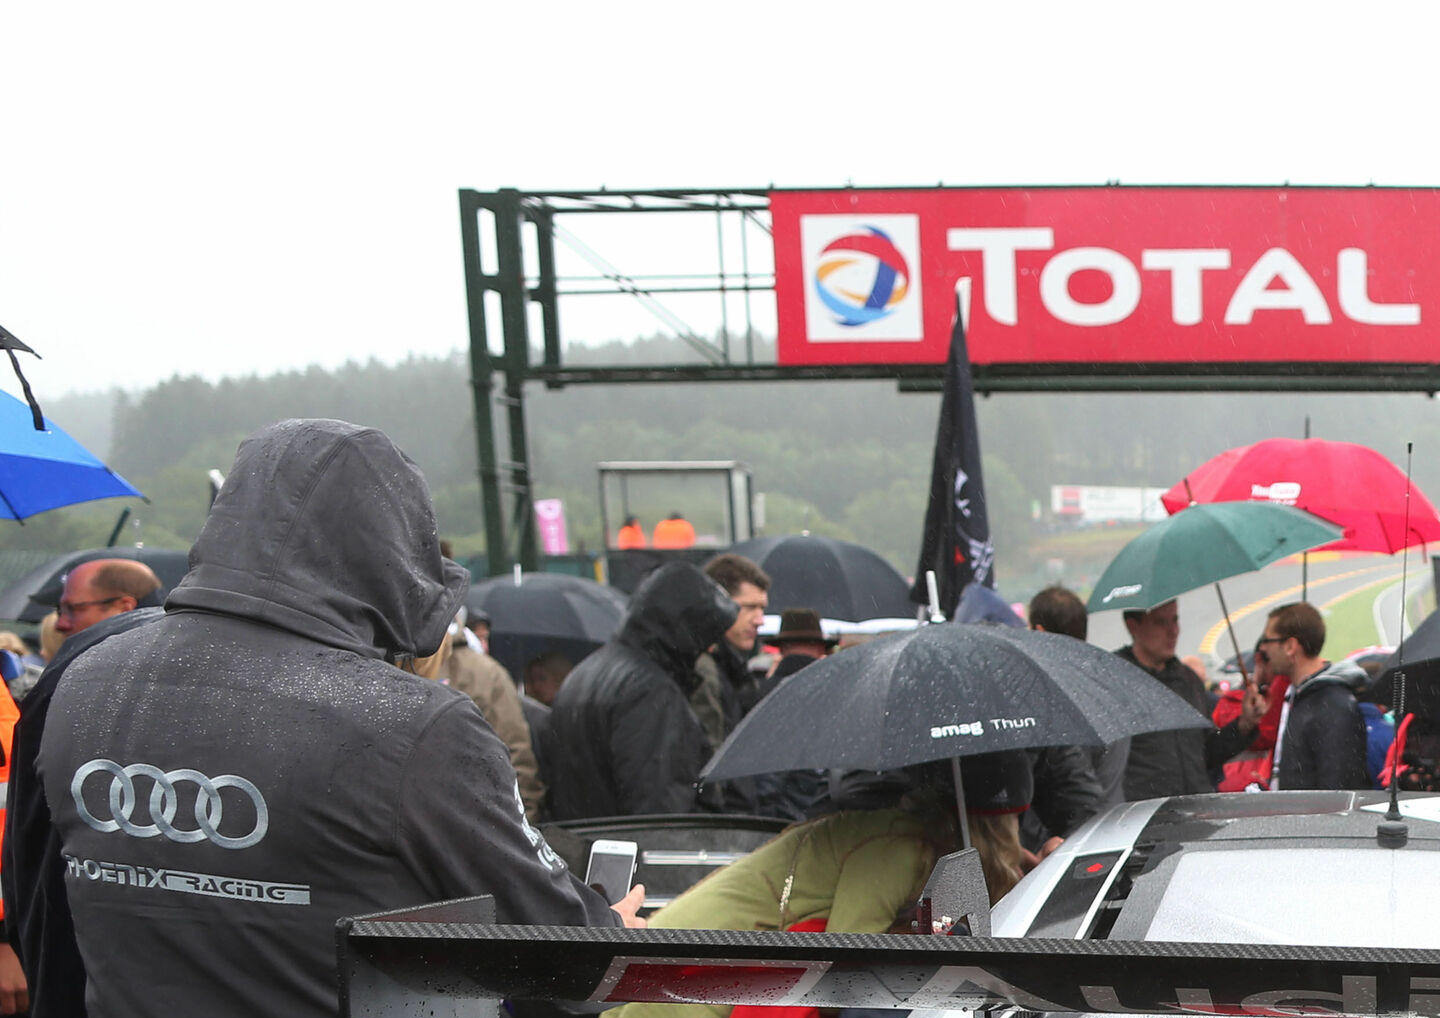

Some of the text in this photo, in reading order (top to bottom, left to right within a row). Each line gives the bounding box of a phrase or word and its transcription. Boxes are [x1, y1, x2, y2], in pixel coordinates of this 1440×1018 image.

[946, 227, 1422, 327] TOTAL
[930, 716, 1037, 739] amag Thun
